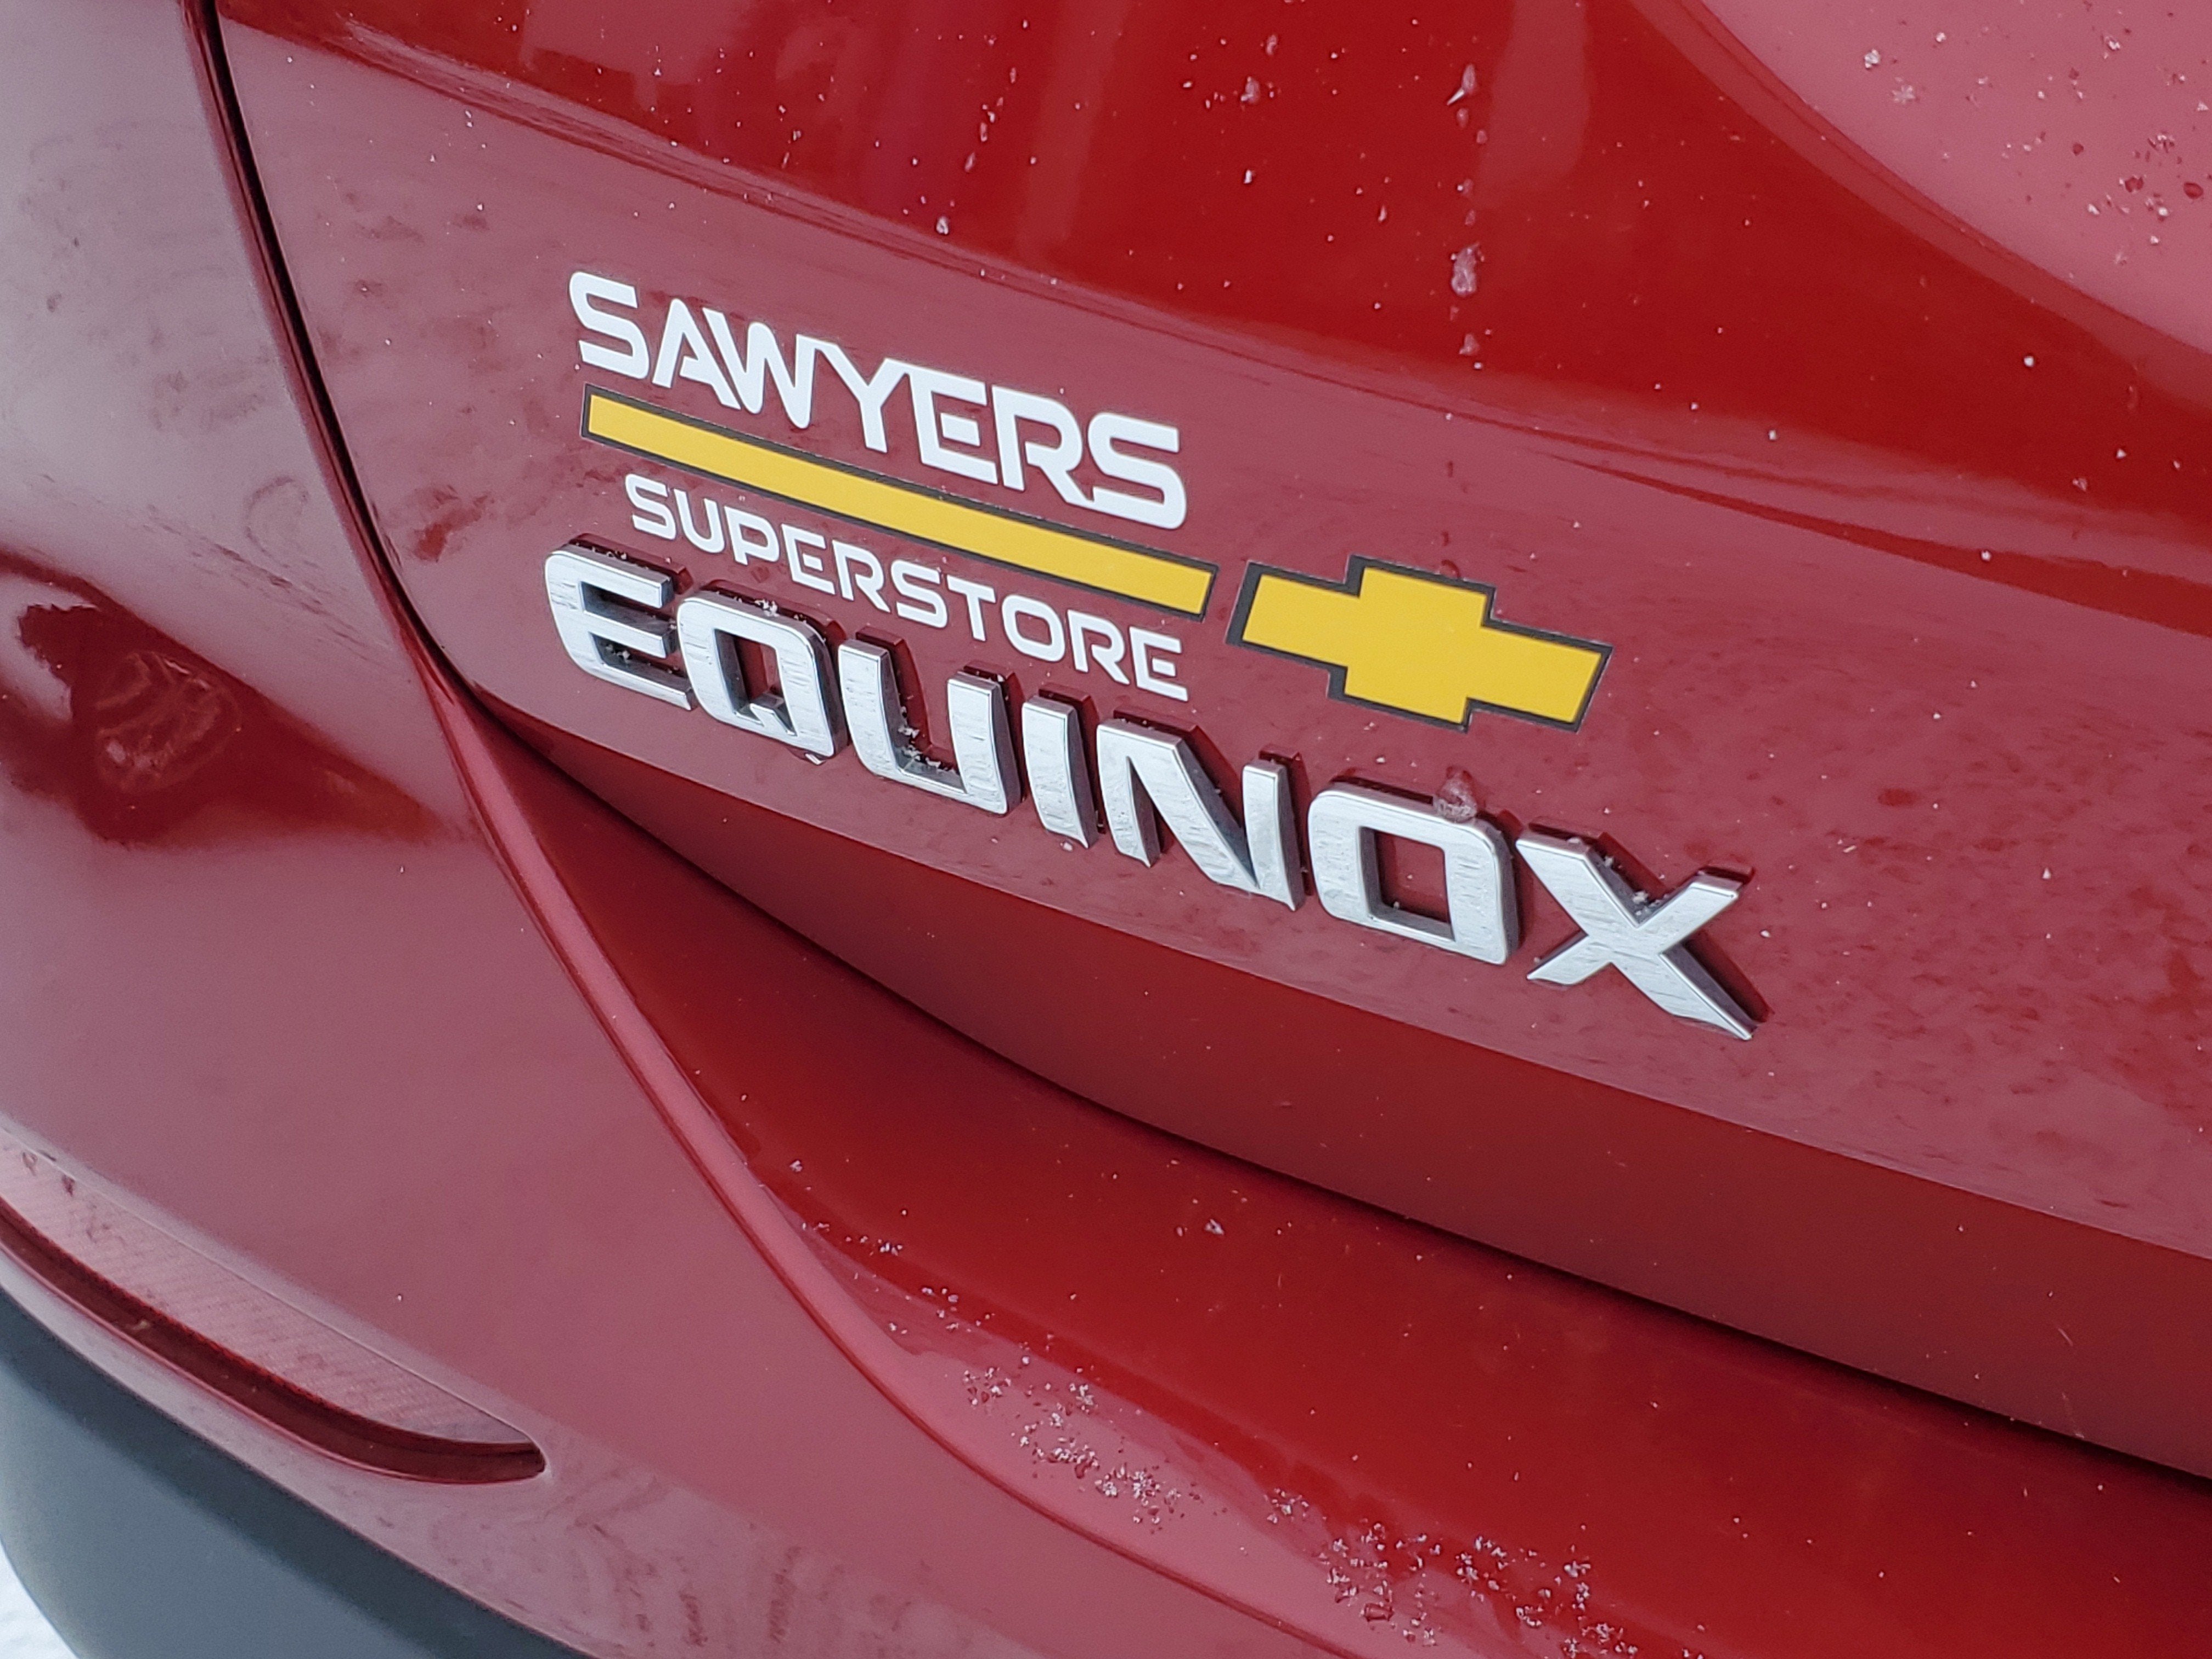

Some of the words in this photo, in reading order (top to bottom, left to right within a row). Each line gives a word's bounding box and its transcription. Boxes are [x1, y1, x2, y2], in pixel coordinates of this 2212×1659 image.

[568, 272, 1188, 529] SAWYERS
[624, 473, 1190, 701] SUPERSTORE
[543, 540, 1764, 1041] EQUINOX
